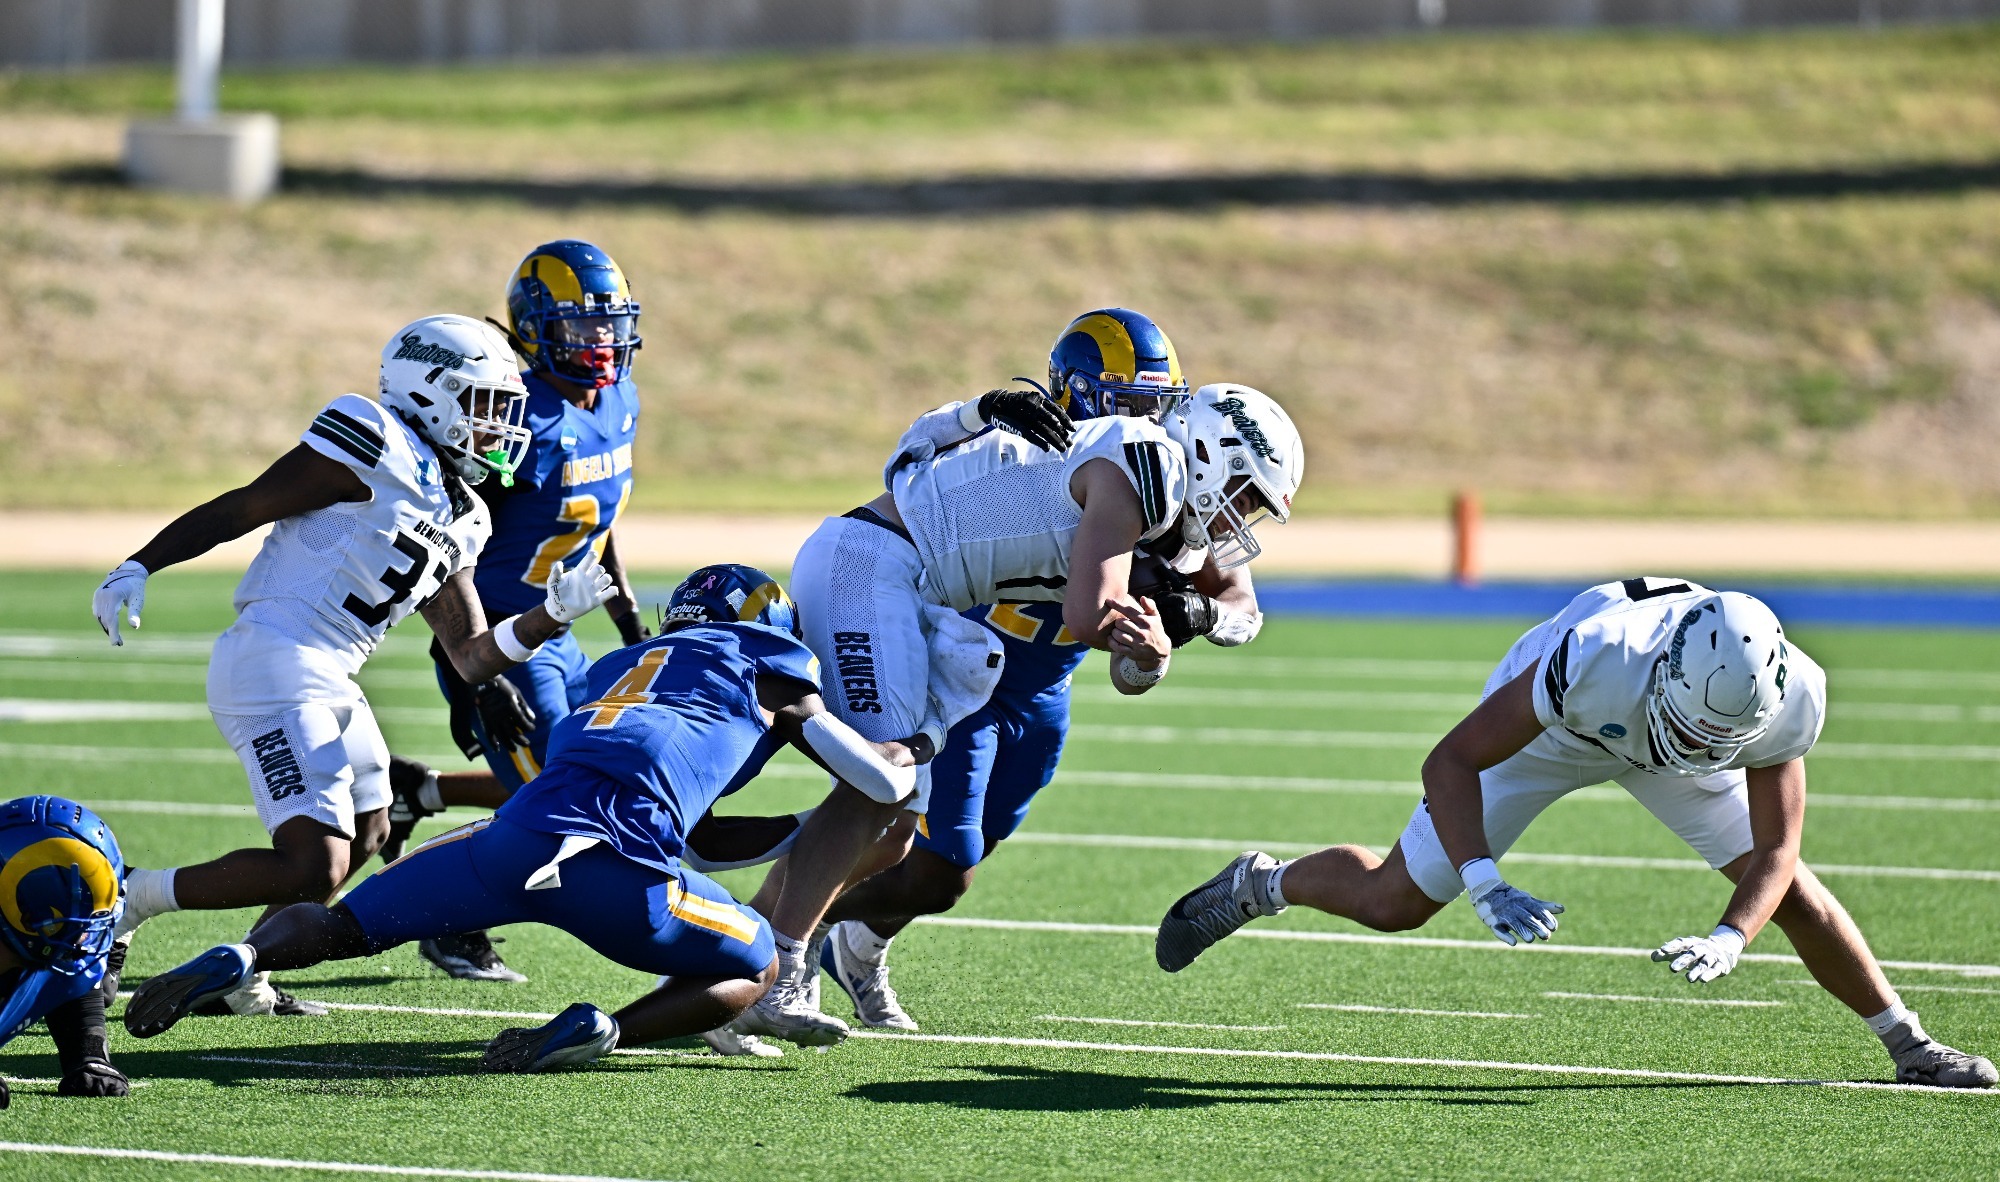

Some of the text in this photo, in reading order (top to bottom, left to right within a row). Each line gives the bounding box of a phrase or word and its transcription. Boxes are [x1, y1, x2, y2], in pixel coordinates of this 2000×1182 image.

[392, 335, 465, 370] Beavers
[1208, 397, 1275, 457] Beavers
[561, 452, 613, 487] ANGELO
[413, 519, 449, 549] BEMIDJI
[573, 646, 675, 730] 4
[834, 632, 882, 713] BEAVERS
[1698, 718, 1733, 734] Riddell
[252, 728, 306, 801] BEAVERS
